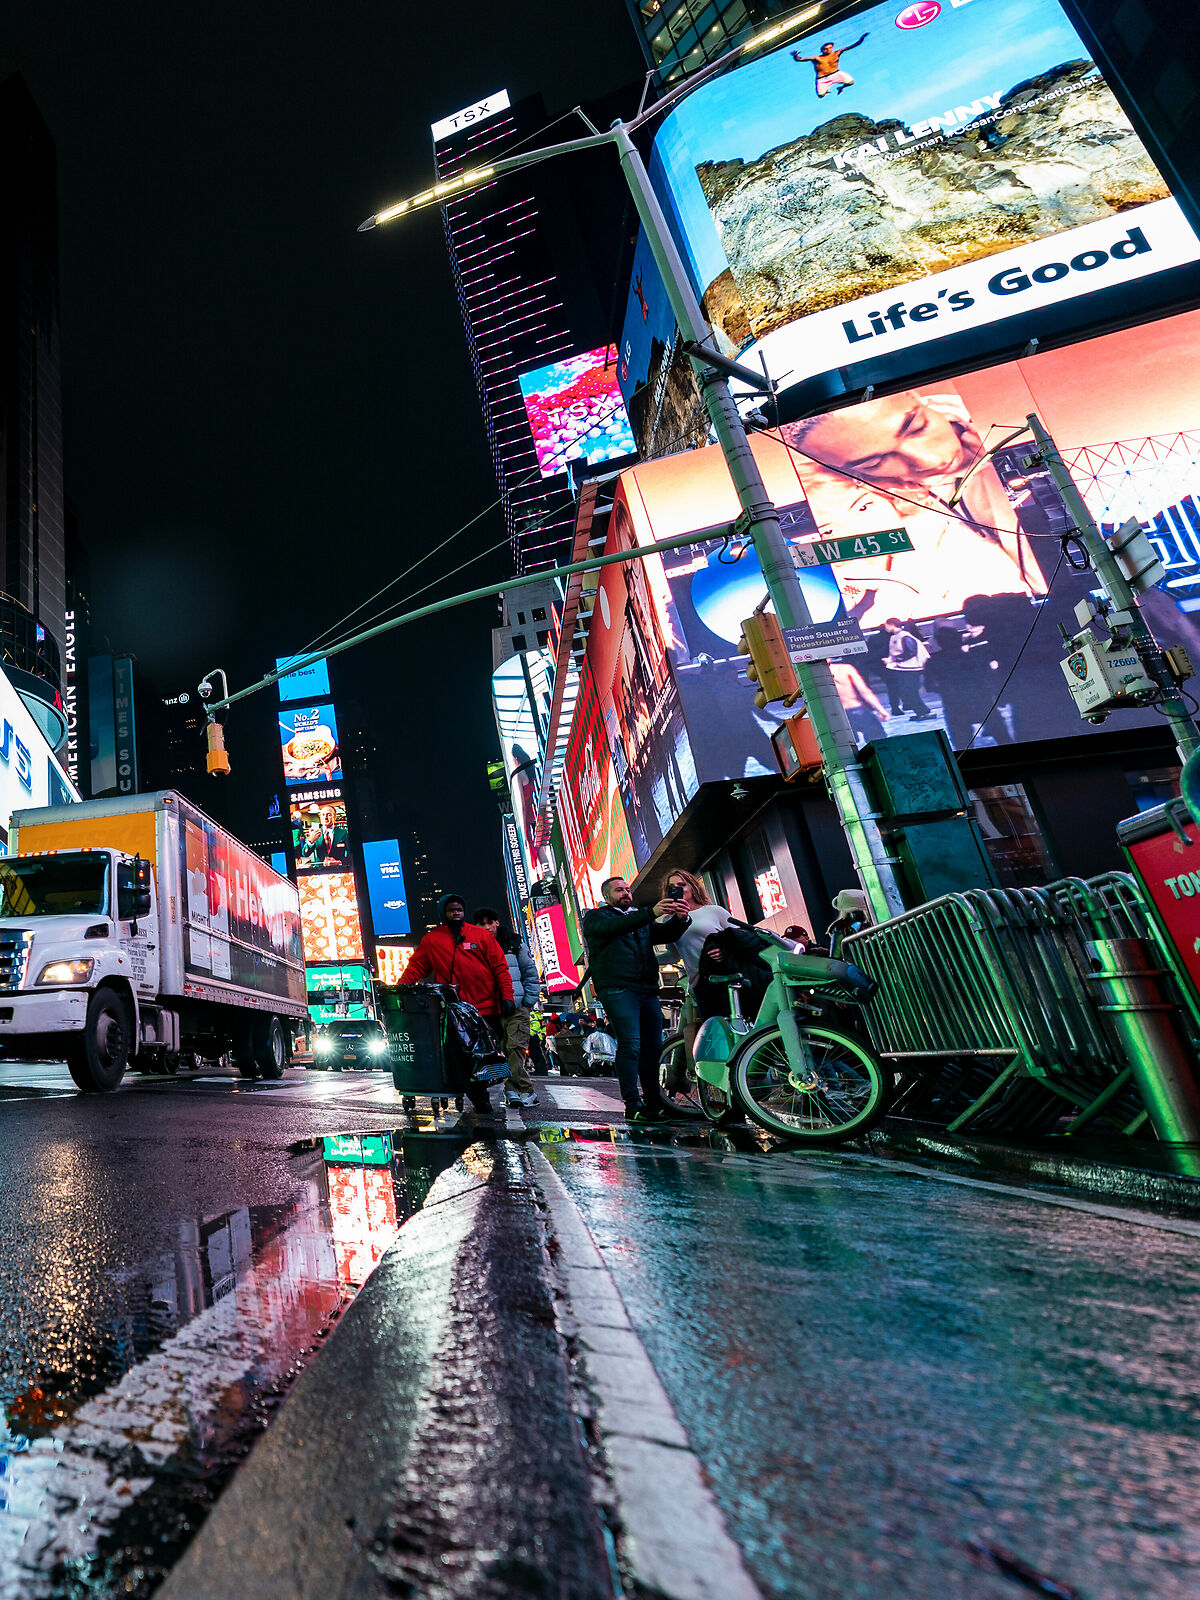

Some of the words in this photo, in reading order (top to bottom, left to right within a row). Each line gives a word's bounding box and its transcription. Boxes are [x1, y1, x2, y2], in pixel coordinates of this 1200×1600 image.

[450, 102, 490, 128] TSX
[945, 75, 1099, 138] #OceanConservationist
[832, 137, 891, 170] KAI
[894, 90, 1003, 147] LENNY
[988, 227, 1153, 295] Good
[547, 393, 612, 426] TSX
[818, 541, 841, 561] W
[854, 536, 881, 555] 45
[889, 531, 906, 544] St
[65, 610, 76, 673] EAGLE
[788, 634, 815, 643] Times
[815, 629, 849, 639] Square
[790, 638, 836, 650] Pedestrian
[836, 635, 860, 643] Plaza
[298, 668, 316, 677] best
[116, 669, 129, 738] TIMES
[67, 685, 78, 786] MERICAN
[290, 788, 342, 802] SAMSUNG
[507, 823, 519, 849] SCREEN
[511, 849, 520, 864] THIS
[513, 864, 524, 882] OVER
[517, 882, 529, 900] TAKE
[388, 1043, 416, 1053] QUARE
